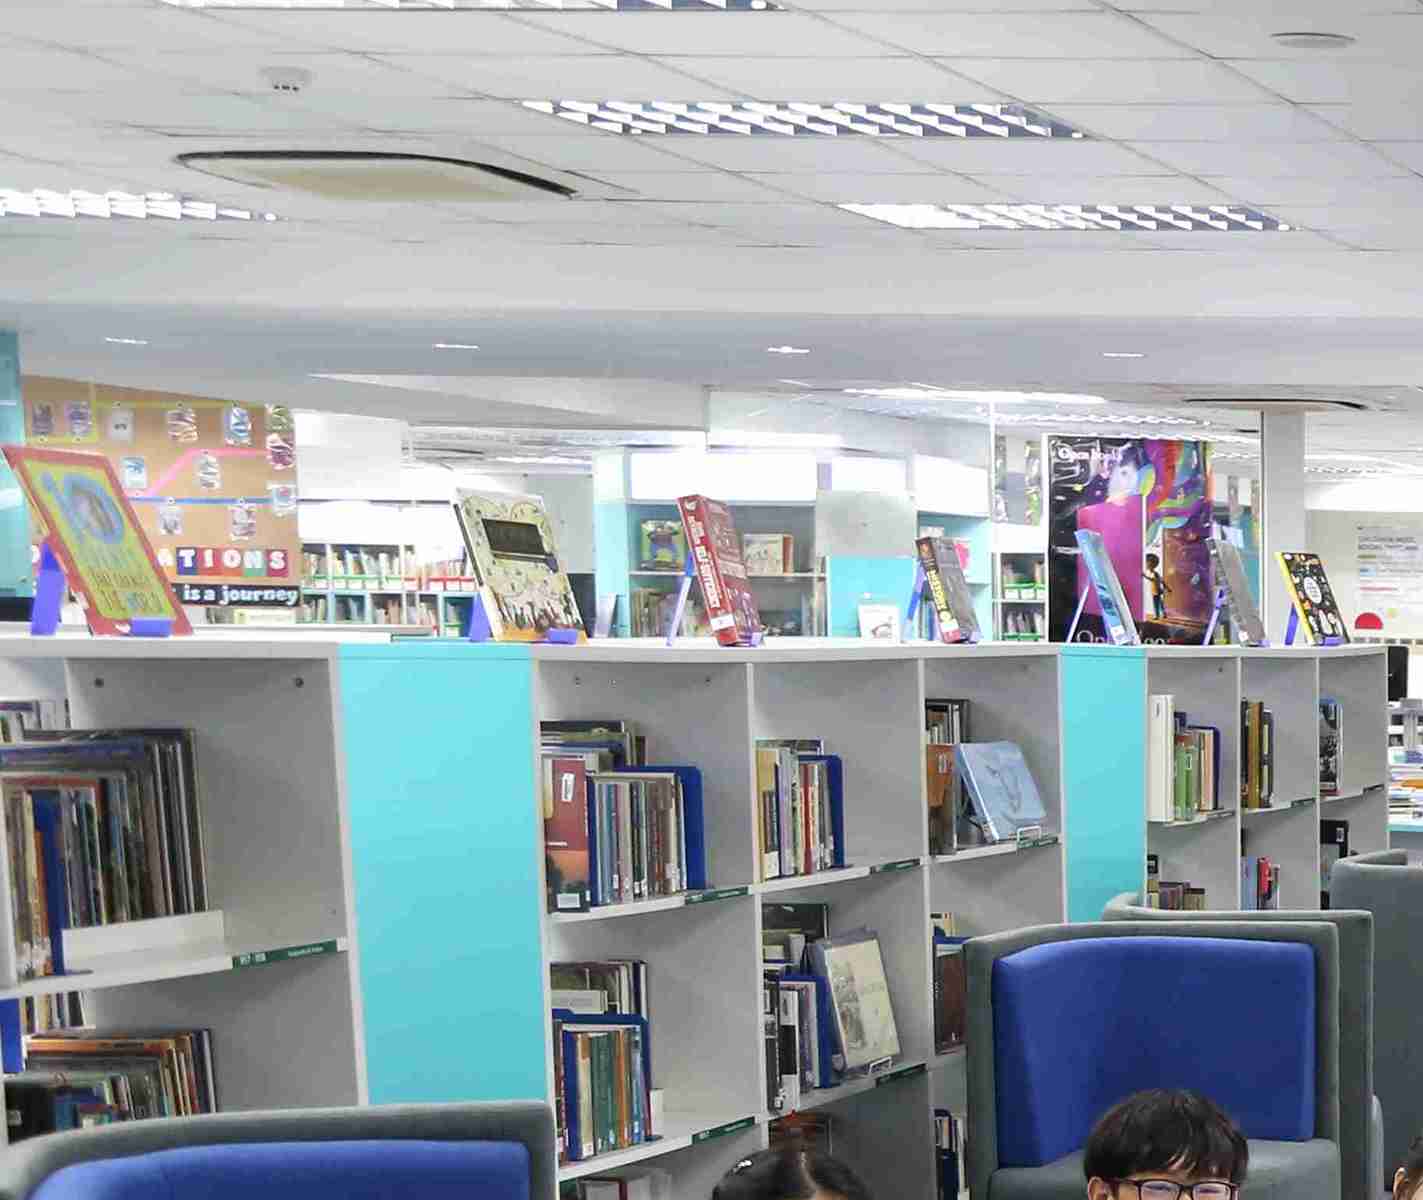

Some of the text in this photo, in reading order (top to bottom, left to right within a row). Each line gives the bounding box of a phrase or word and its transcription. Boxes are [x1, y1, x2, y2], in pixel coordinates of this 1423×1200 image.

[183, 585, 299, 606] is a journey
